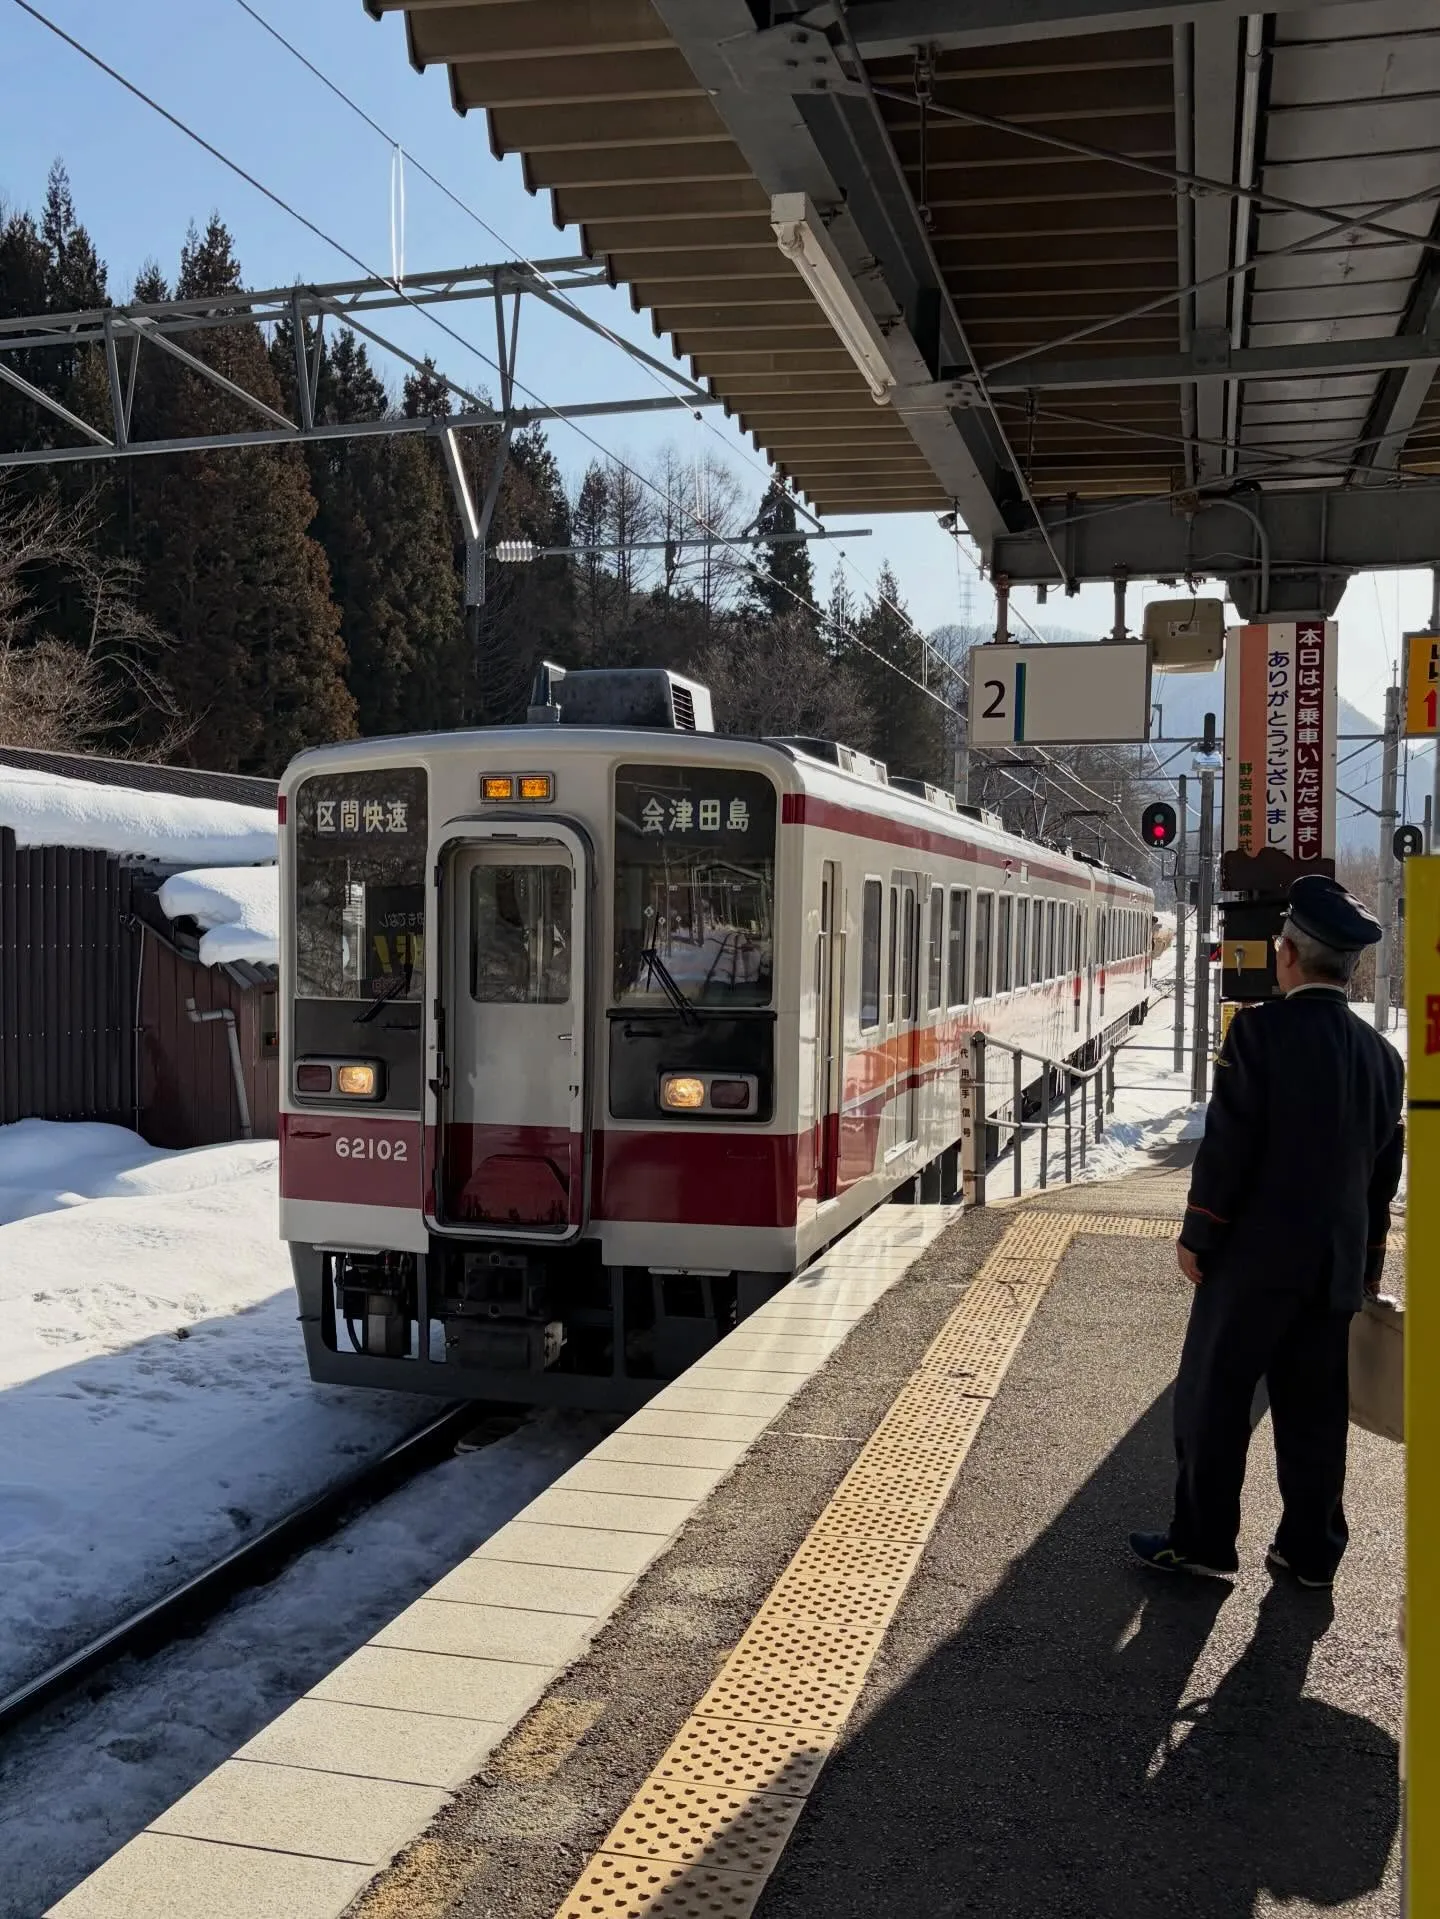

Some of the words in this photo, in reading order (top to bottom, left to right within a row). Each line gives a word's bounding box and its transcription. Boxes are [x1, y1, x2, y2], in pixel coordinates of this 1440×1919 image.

[981, 679, 1006, 719] 2
[1265, 650, 1290, 852] ありがとうございまし
[1296, 628, 1322, 861] 本日はご乗車いただきまし
[316, 799, 408, 833] 区間快速
[641, 797, 750, 836] 会津田島
[960, 1047, 972, 1139] 代用手信号
[335, 1136, 408, 1162] 62102
